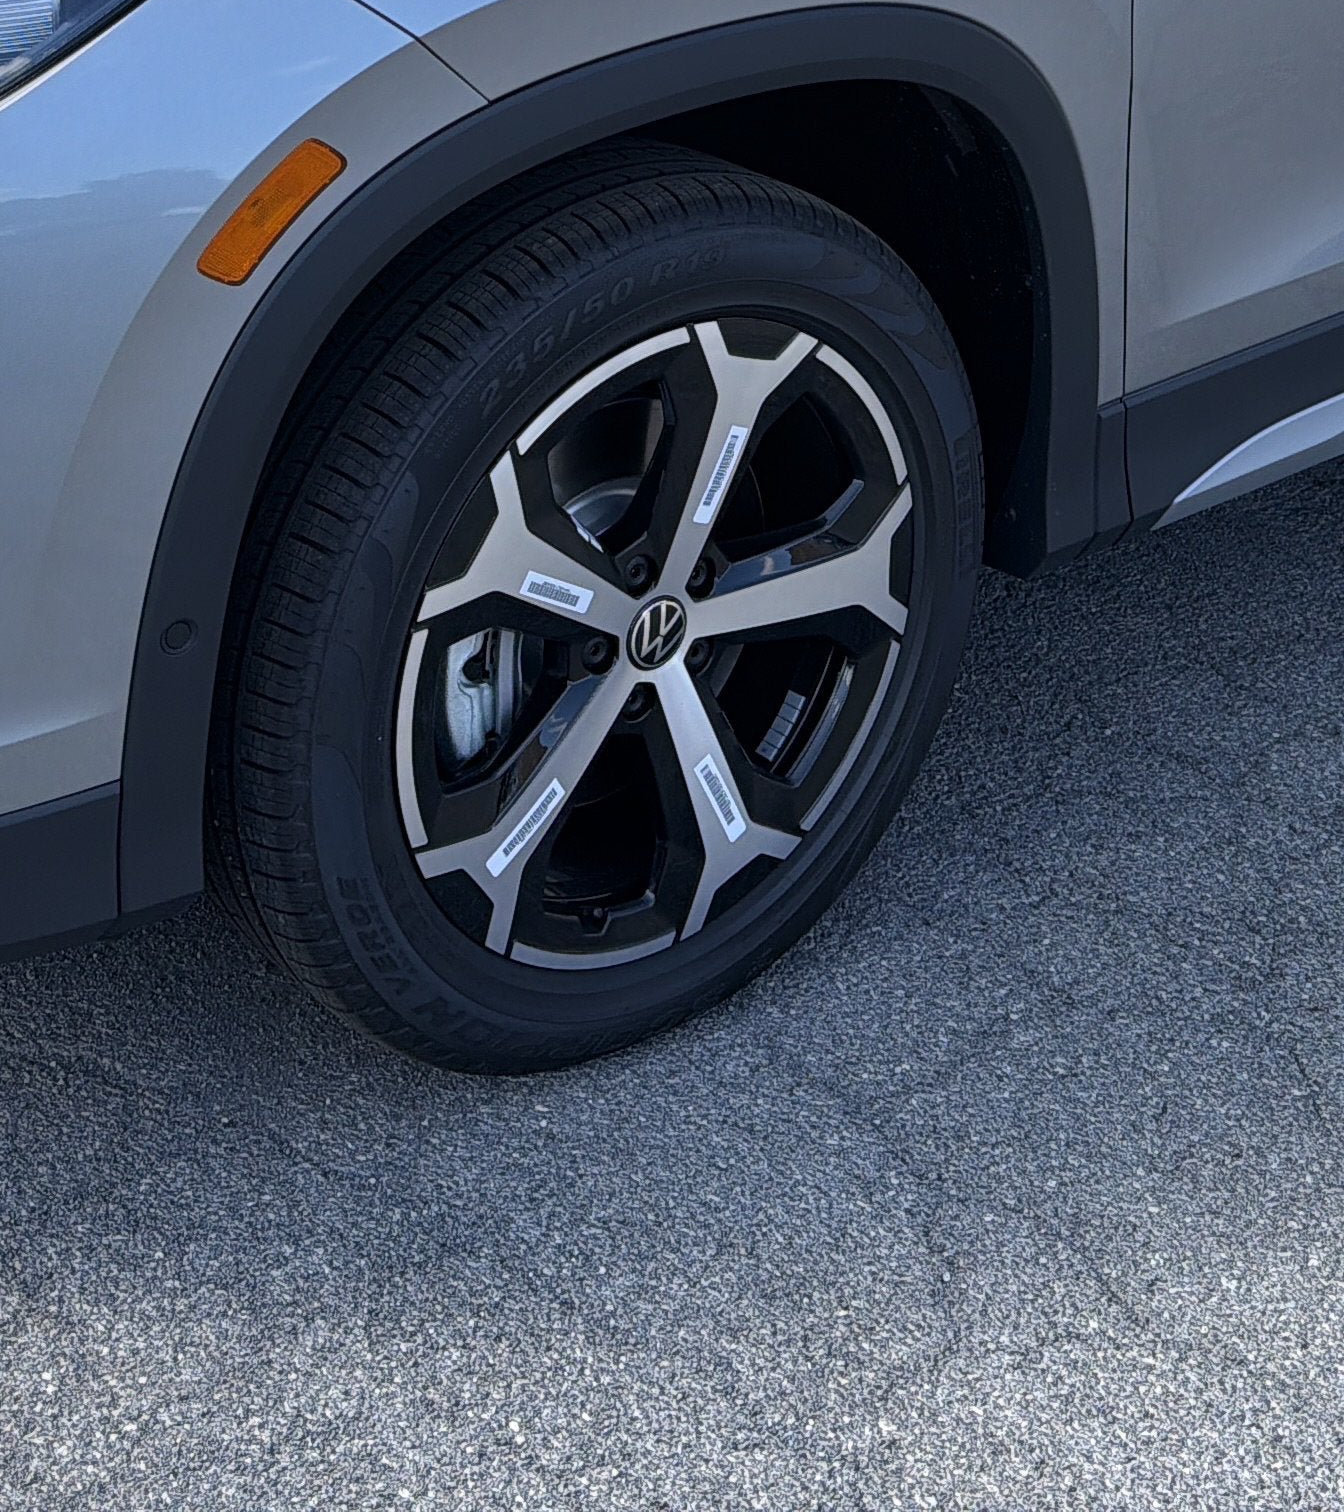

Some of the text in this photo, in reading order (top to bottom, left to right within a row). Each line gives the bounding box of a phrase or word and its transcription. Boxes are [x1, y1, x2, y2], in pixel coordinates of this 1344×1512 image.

[477, 276, 634, 420] 235/50
[649, 244, 727, 287] R19
[628, 596, 686, 669] VW
[335, 873, 414, 996] VERDE
